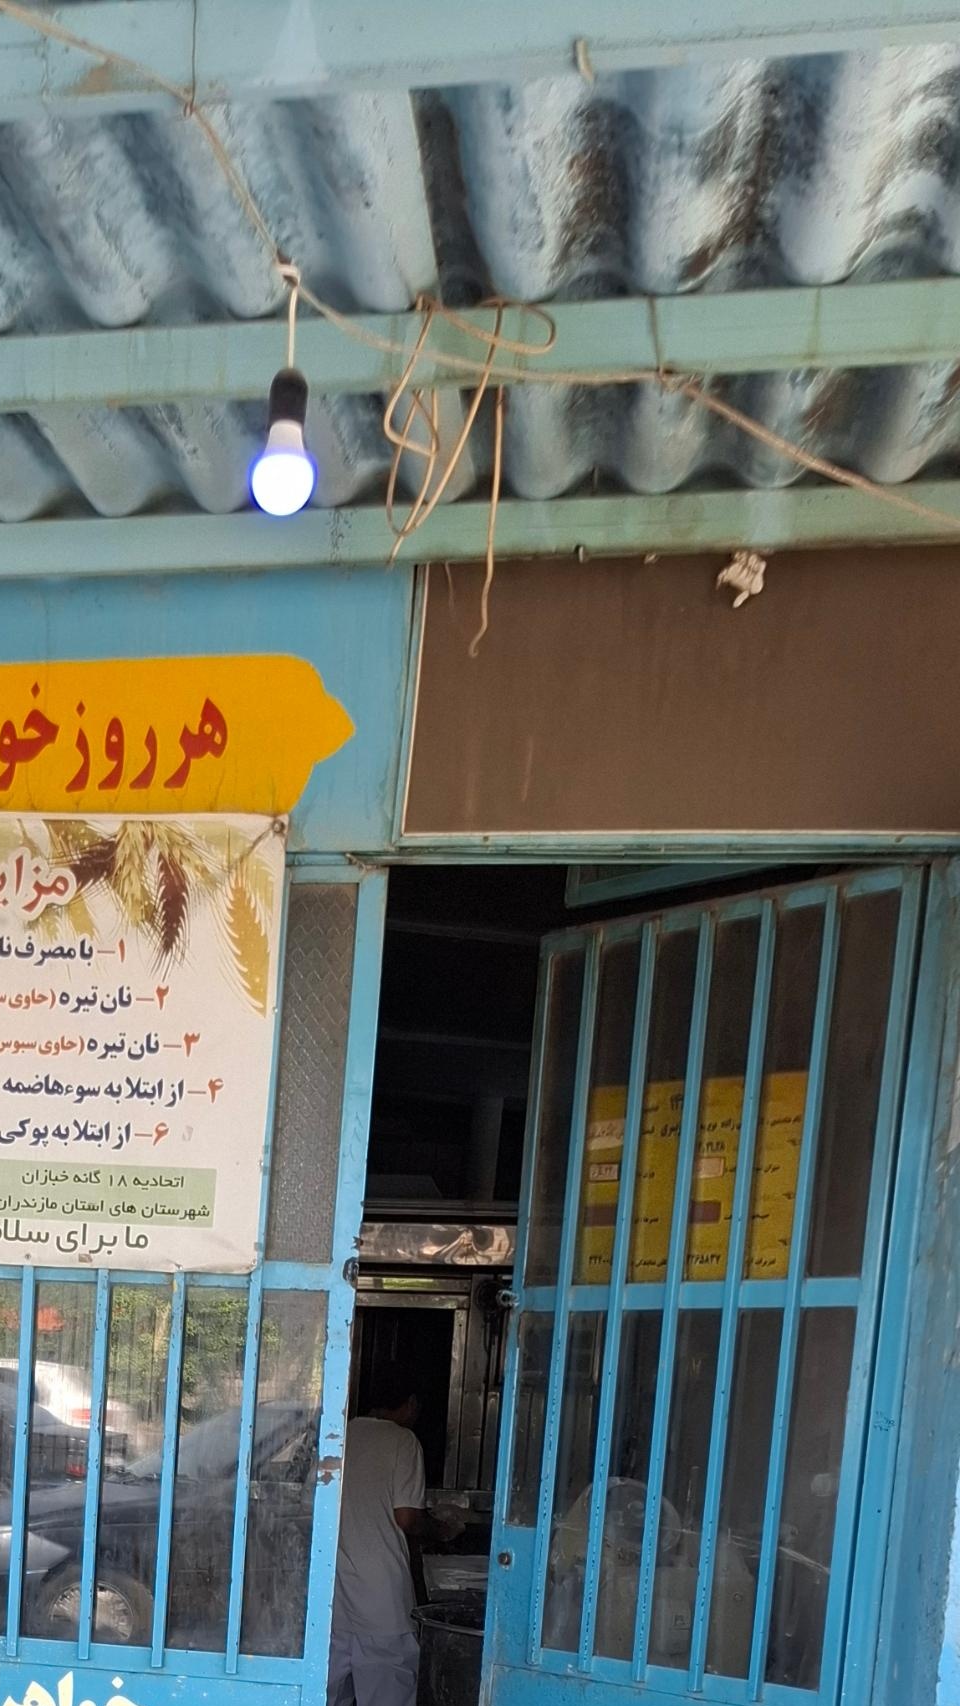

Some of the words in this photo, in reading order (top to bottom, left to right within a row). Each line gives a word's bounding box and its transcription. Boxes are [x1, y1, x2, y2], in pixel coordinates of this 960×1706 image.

[65, 700, 157, 794] روز
[164, 697, 228, 790] هر
[14, 936, 77, 966] مصرف
[79, 938, 94, 967] با
[7, 990, 57, 1010] (حاوی
[59, 991, 98, 1013] تیره
[99, 985, 132, 1014] نان
[39, 1035, 85, 1056] (حاوی
[86, 1032, 126, 1060] تیره
[127, 1032, 160, 1061] نان
[2, 1074, 101, 1104] سوءهاضمه
[103, 1081, 123, 1104] به
[125, 1076, 164, 1106] ابتلا
[165, 1079, 184, 1108] از
[51, 1124, 70, 1146] به
[72, 1119, 111, 1148] ابتلا
[111, 1122, 131, 1150] از
[21, 1169, 69, 1185] خبازان
[71, 1169, 101, 1185] گانه
[108, 1174, 128, 1188] ۱۸
[132, 1175, 185, 1191] اتحادیه
[61, 1200, 104, 1215] استان
[108, 1199, 137, 1217] های
[141, 1202, 211, 1221] شهرستان
[55, 1224, 118, 1255] برای
[125, 1226, 150, 1250] ما
